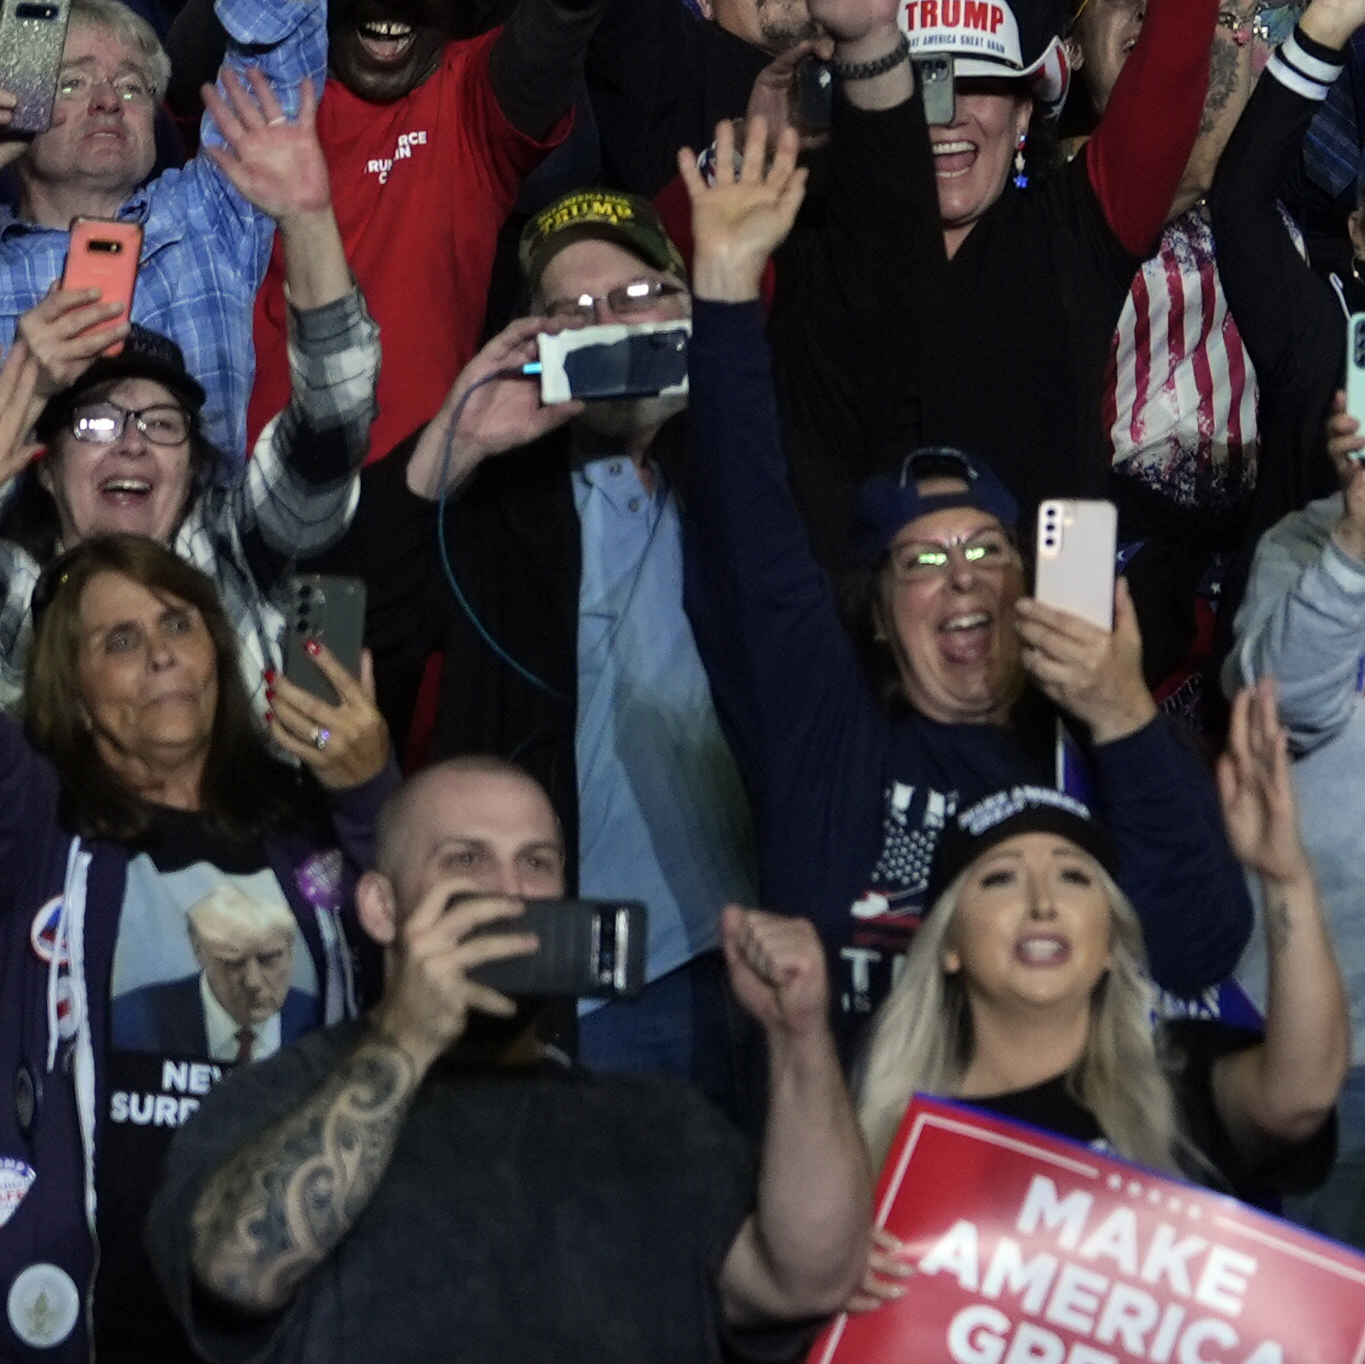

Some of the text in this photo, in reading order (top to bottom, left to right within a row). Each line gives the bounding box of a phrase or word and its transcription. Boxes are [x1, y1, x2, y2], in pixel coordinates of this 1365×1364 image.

[906, 0, 1004, 34] TRUMP
[923, 35, 957, 46] AMERICA
[960, 35, 984, 48] GREAT
[1016, 1175, 1259, 1318] MAKE
